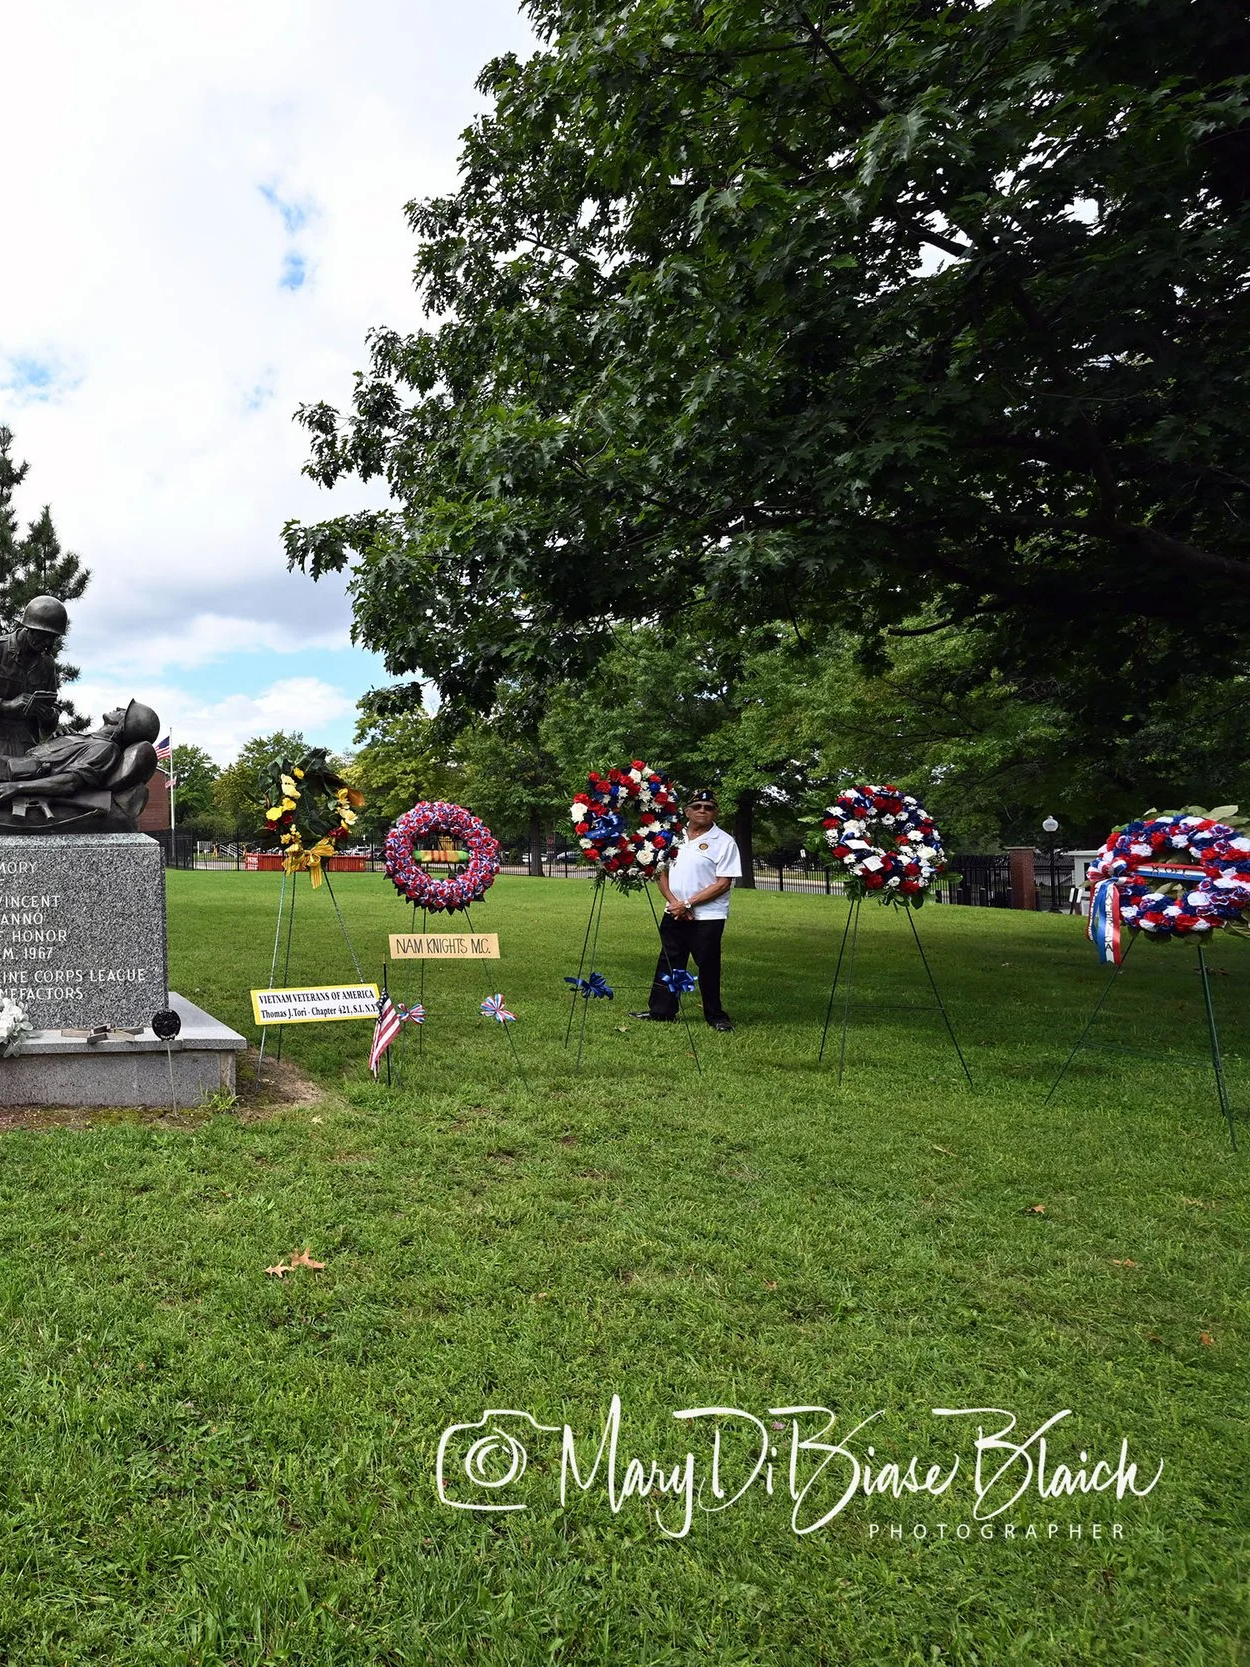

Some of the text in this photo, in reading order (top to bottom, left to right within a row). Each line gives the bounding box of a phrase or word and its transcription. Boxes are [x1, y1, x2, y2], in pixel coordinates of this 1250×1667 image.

[13, 929, 68, 943] HONOR
[24, 946, 53, 959] 1967
[396, 938, 424, 954] NAM
[426, 938, 468, 954] KNIGHTS
[34, 969, 83, 983] CORPS
[90, 968, 146, 982] LEAGUE
[259, 989, 375, 1004] VIETNAM VETERANS OF AMERICA
[261, 1009, 287, 1019] Thomas
[311, 1006, 337, 1017] Chapter
